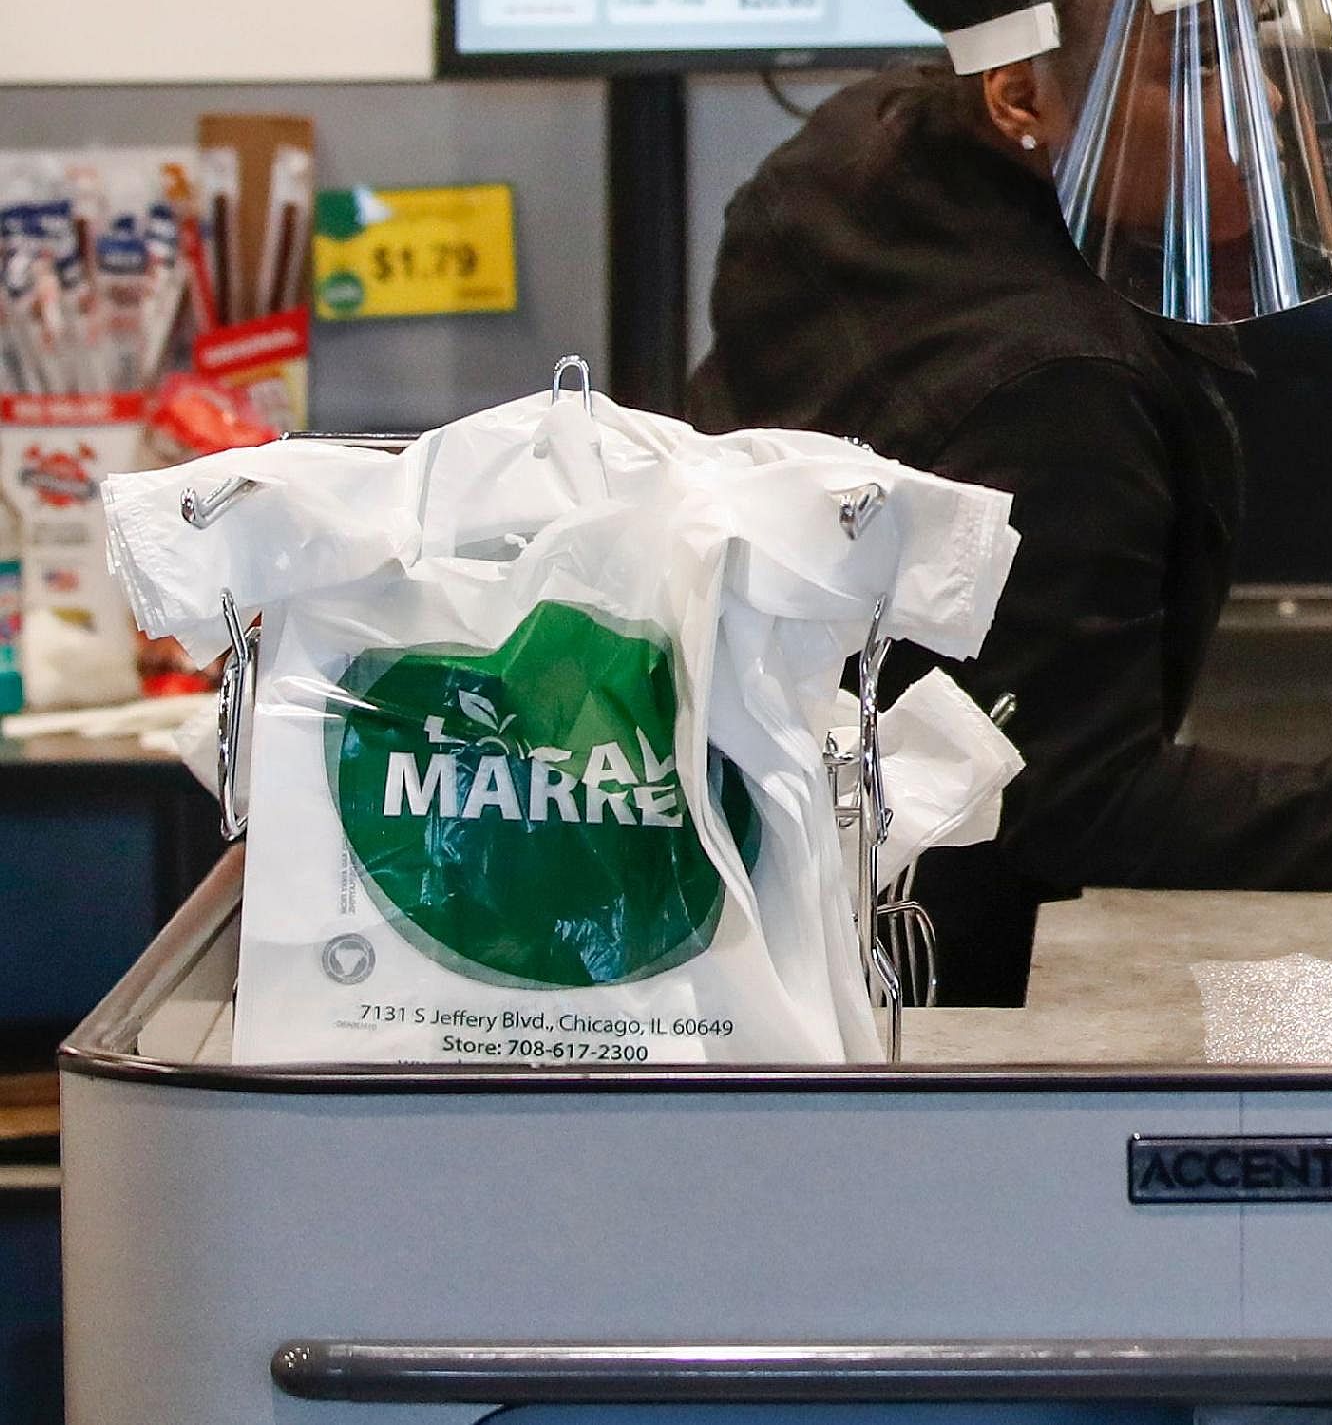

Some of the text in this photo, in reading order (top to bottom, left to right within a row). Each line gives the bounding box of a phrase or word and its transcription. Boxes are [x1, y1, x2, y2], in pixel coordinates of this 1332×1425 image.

[372, 241, 479, 284] $1.79
[360, 1004, 734, 1037] 7131 S Jeffery Blvd., Chicago, IL 60649
[442, 1034, 650, 1062] Store: 708-617-2300
